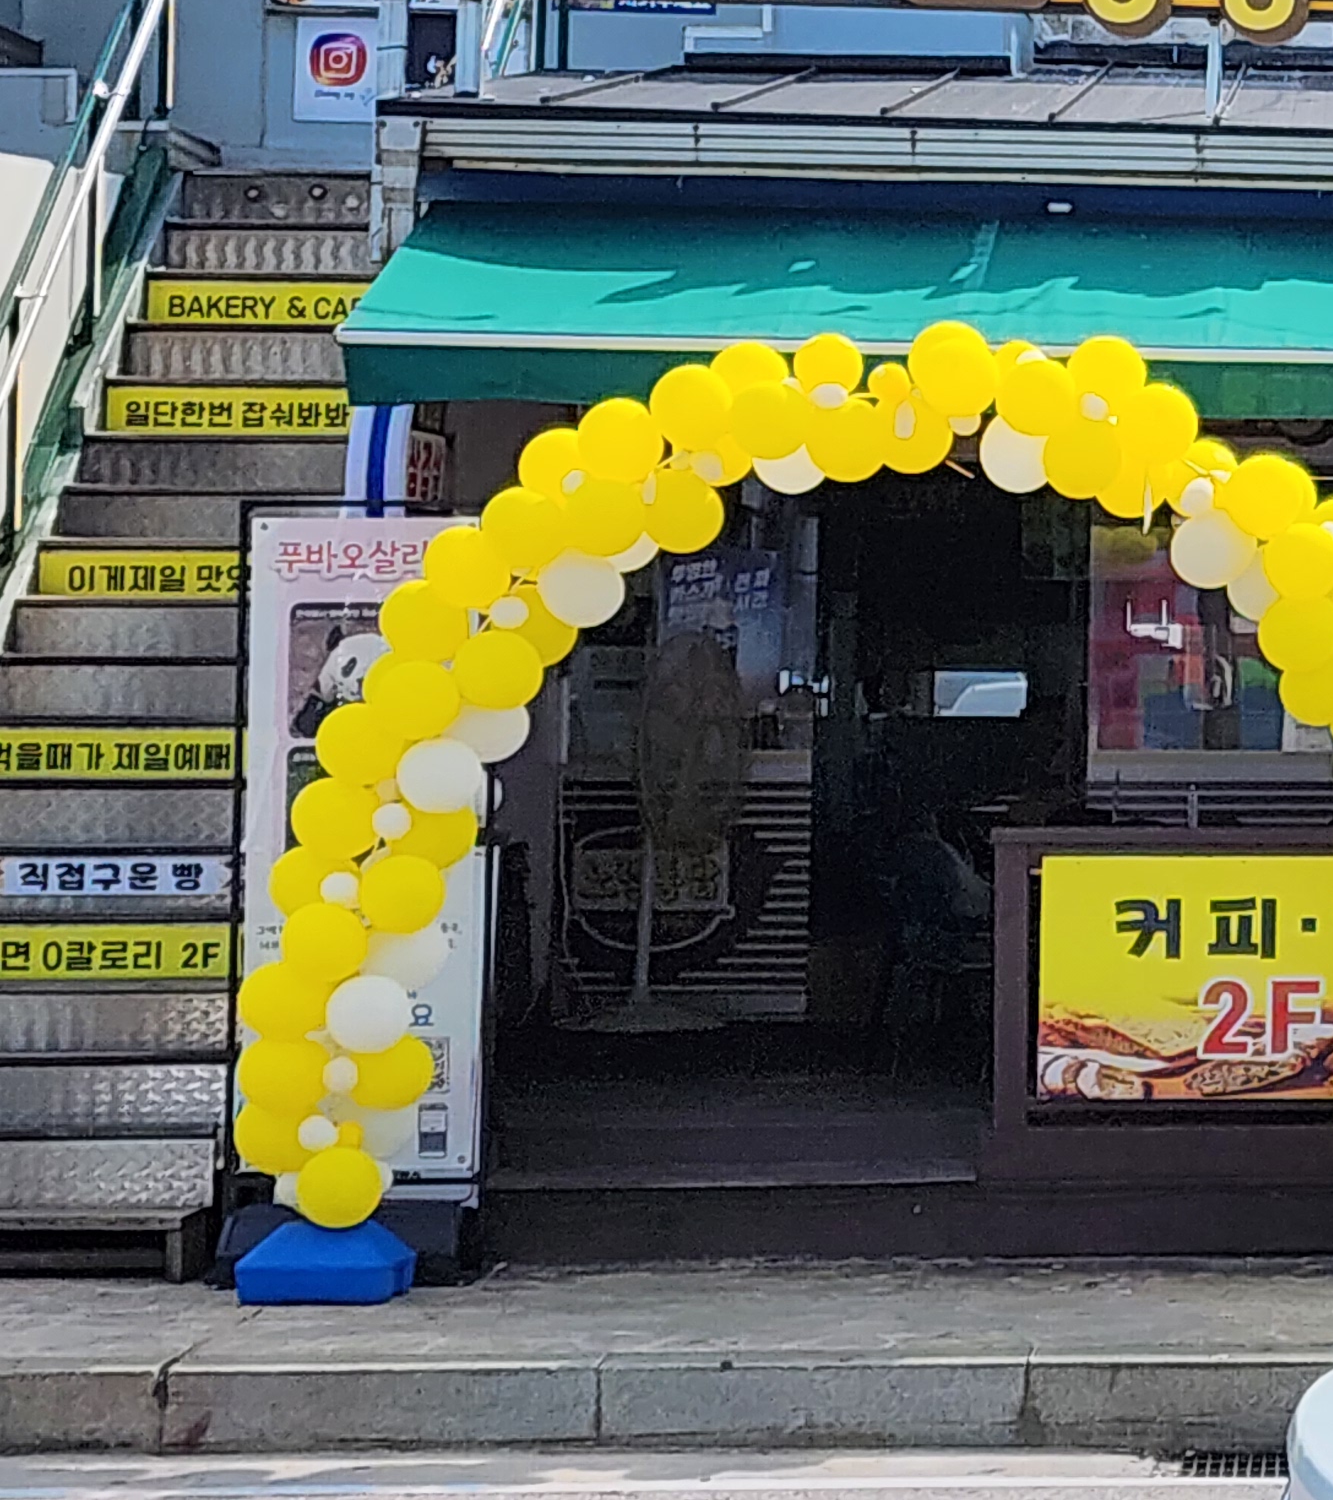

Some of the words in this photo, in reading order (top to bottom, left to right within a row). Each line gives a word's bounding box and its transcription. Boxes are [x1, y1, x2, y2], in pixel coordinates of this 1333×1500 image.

[168, 295, 276, 319] BAKERY
[287, 296, 306, 318] &
[313, 297, 361, 320] CA
[126, 401, 233, 428] 일단한번
[68, 565, 186, 593] 이게제일
[112, 743, 231, 771] 제일예뻐
[19, 863, 157, 891] 직접구운
[172, 864, 202, 890] 빵
[42, 941, 162, 971] 0칼로리
[181, 943, 220, 969] 2F
[1201, 980, 1323, 1054] 2F
